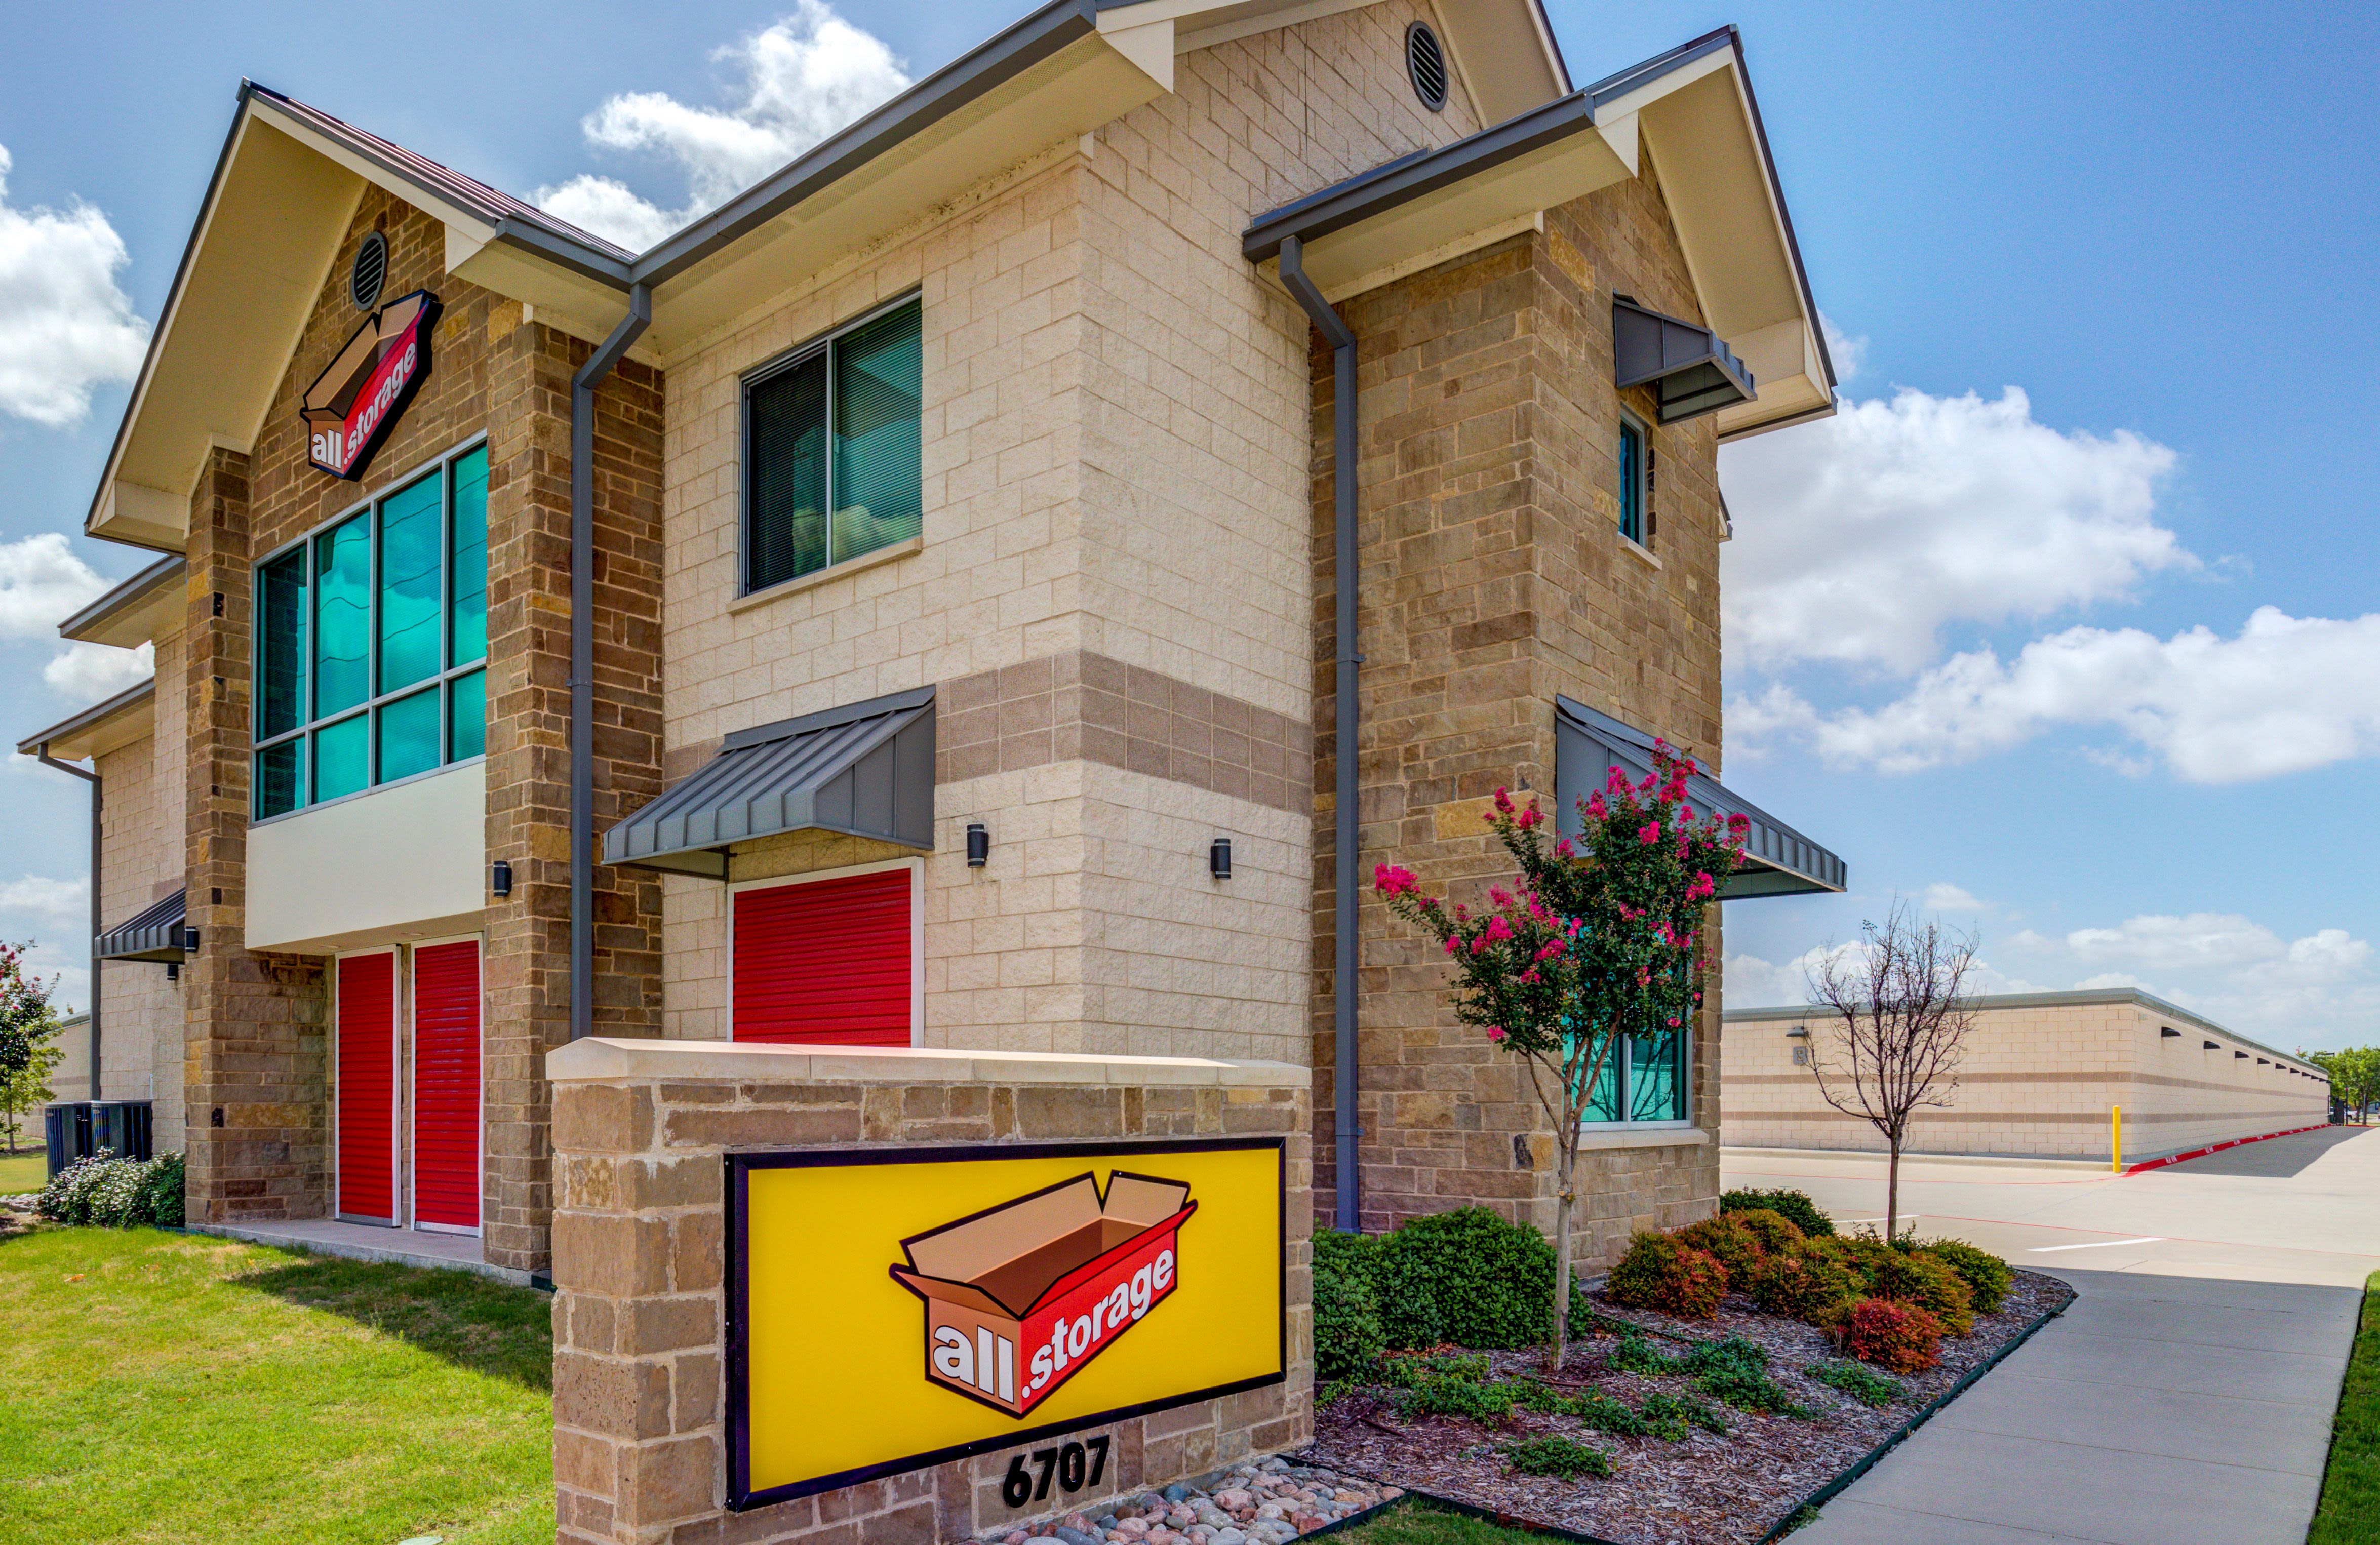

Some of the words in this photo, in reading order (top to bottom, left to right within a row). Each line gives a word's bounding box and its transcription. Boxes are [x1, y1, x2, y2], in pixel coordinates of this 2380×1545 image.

[312, 429, 342, 469] all
[933, 1325, 1014, 1405] all
[1003, 1434, 1110, 1508] 6707
